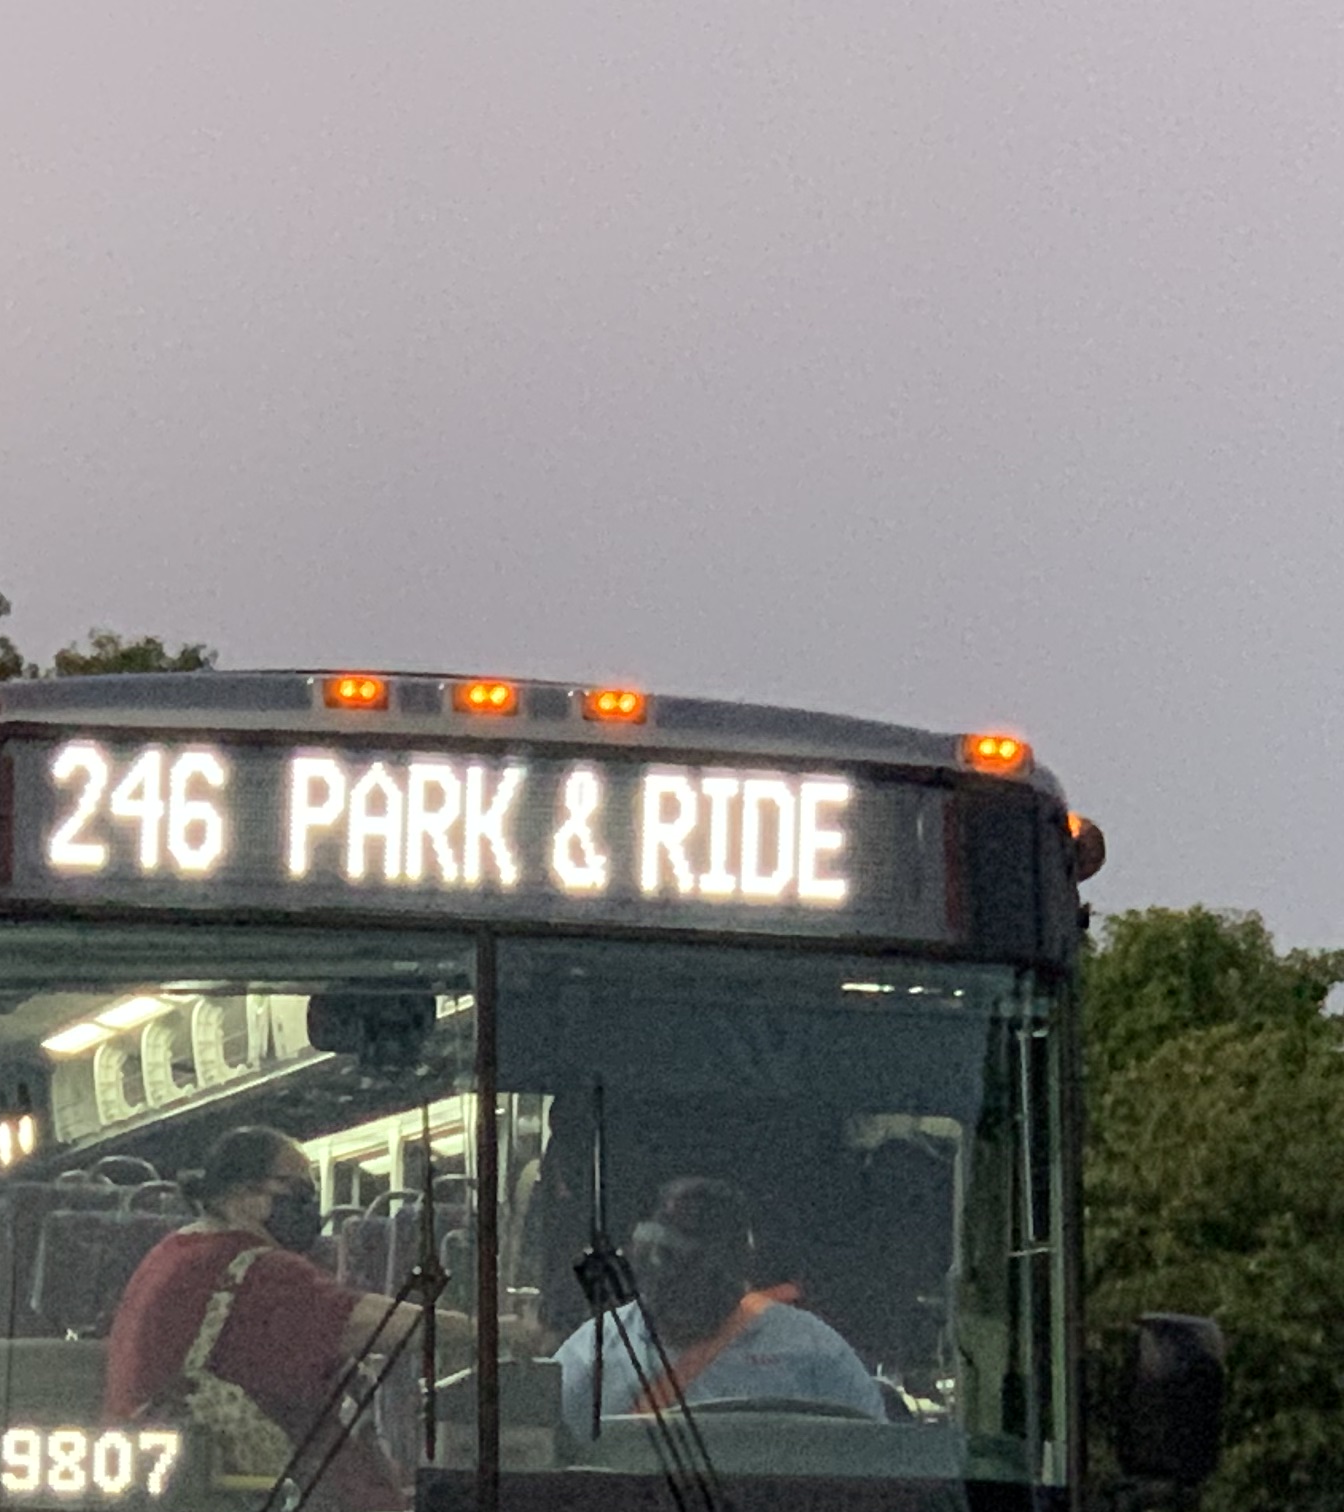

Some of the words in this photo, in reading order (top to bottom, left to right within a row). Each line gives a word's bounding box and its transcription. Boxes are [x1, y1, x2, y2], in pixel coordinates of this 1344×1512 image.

[48, 739, 227, 880] 246
[288, 755, 524, 886] PARK
[551, 771, 608, 891] &
[640, 773, 852, 902] RIDE
[1, 1427, 179, 1495] 9807
